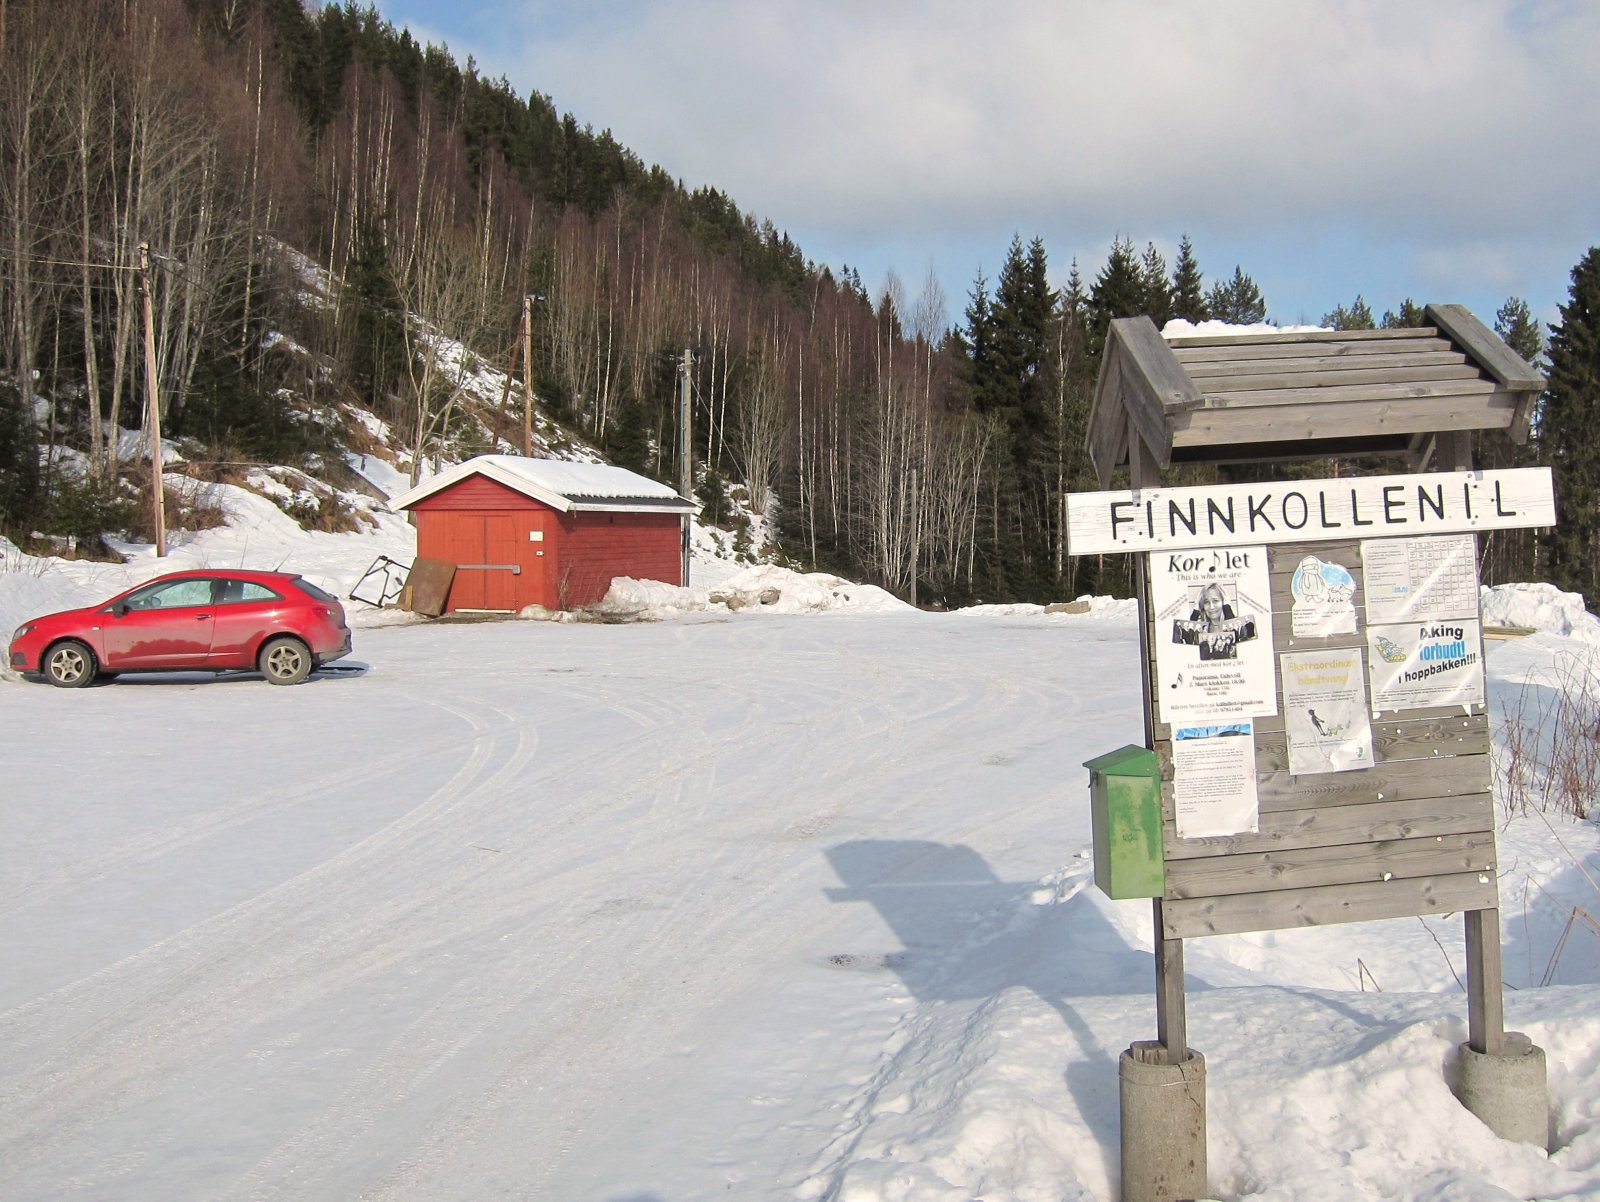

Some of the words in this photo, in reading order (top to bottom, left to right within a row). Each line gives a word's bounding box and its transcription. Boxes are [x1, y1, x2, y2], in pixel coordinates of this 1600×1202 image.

[1110, 484, 1445, 540] FINNKOLLEN
[1168, 554, 1205, 572] Kor
[1225, 551, 1250, 569] let
[1176, 573, 1191, 581] This
[1200, 572, 1216, 580] who
[1404, 652, 1477, 682] hoppbakken!!!
